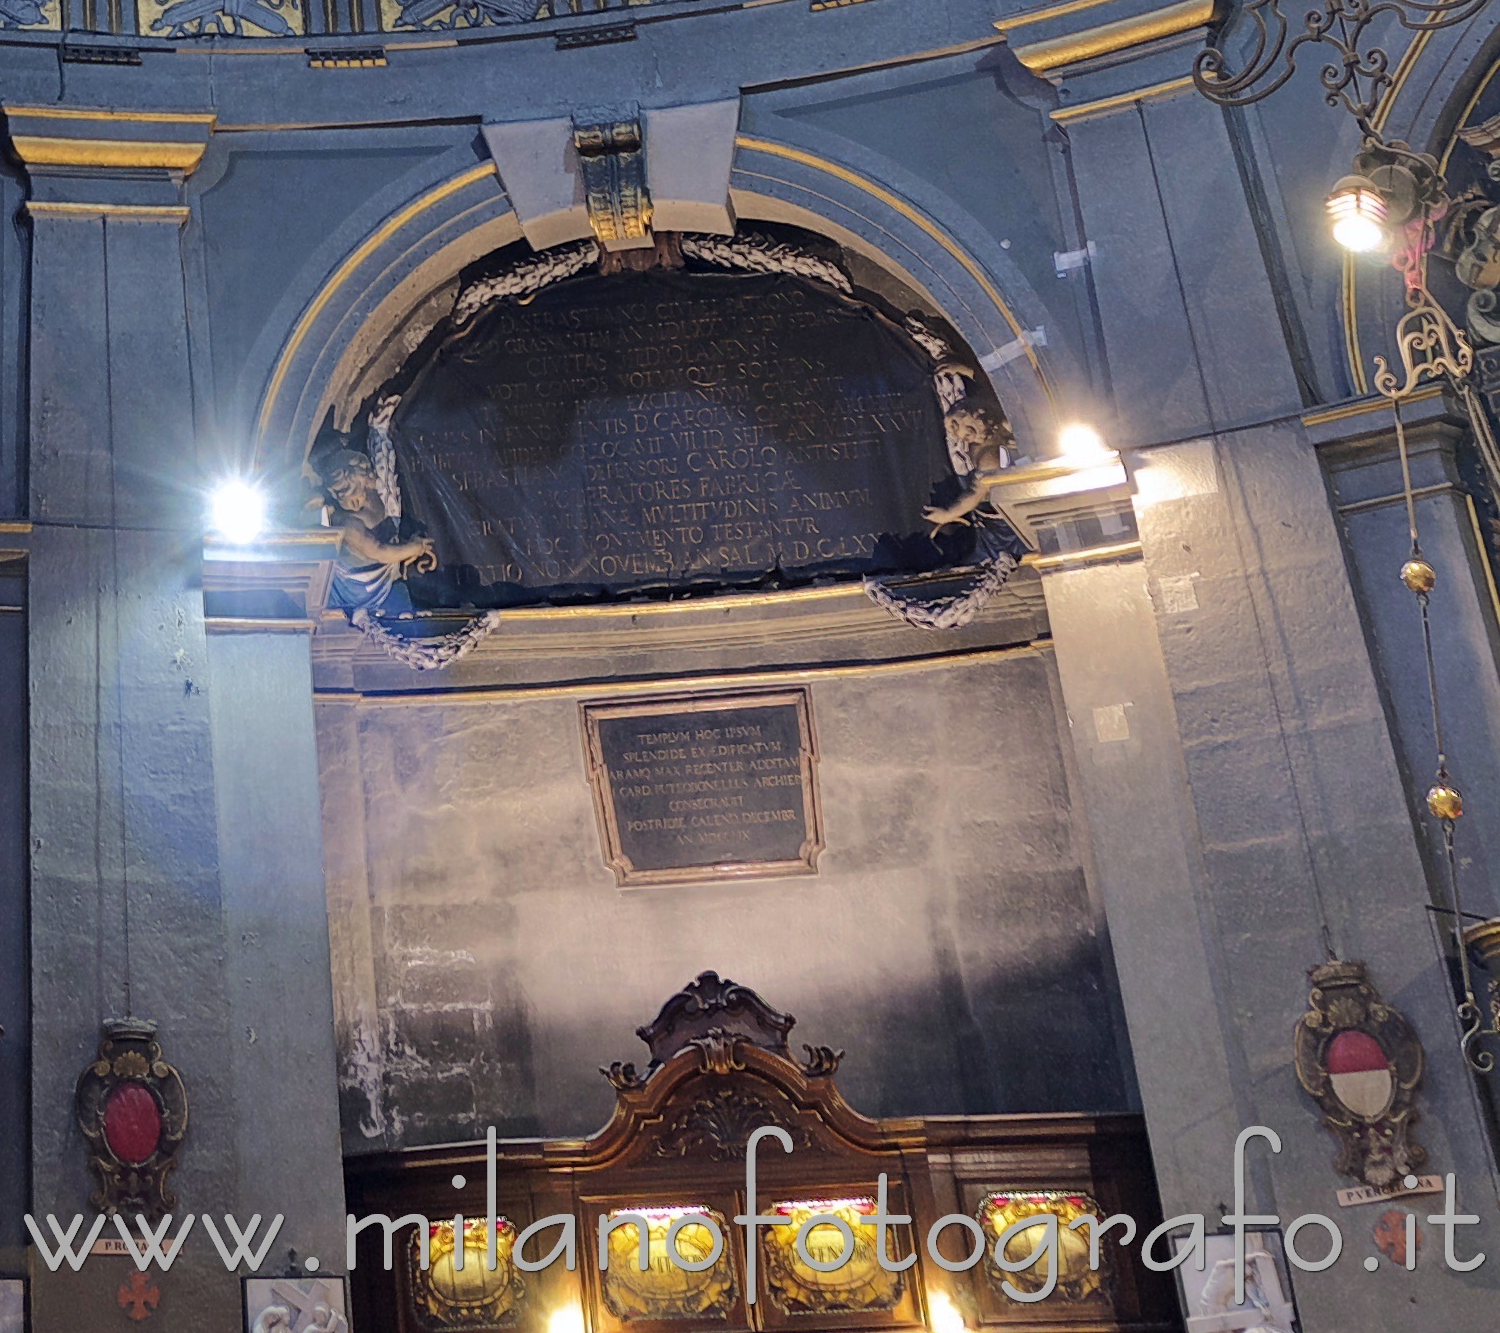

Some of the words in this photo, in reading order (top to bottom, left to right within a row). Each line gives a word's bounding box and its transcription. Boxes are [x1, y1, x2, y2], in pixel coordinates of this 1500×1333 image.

[526, 353, 607, 377] CIVITAS
[614, 336, 778, 370] MEDIOLANENSIS
[626, 385, 750, 412] EXCITANDVM
[653, 405, 748, 431] CAROLVS
[687, 446, 777, 471] CAROLO
[642, 497, 778, 523] MVLTITVDINIS
[787, 488, 873, 513] ANIMVM
[709, 517, 820, 541] TESTANTVR
[637, 731, 690, 745] TEMPLVM
[695, 729, 721, 740] HOC
[725, 725, 762, 738] IPSVM
[622, 748, 687, 764] SPLENDIDE
[655, 765, 681, 776] MAX
[685, 760, 744, 775] RECENTER
[669, 795, 744, 812] CONSECRAVIT
[627, 817, 687, 832] POSTRIDIE
